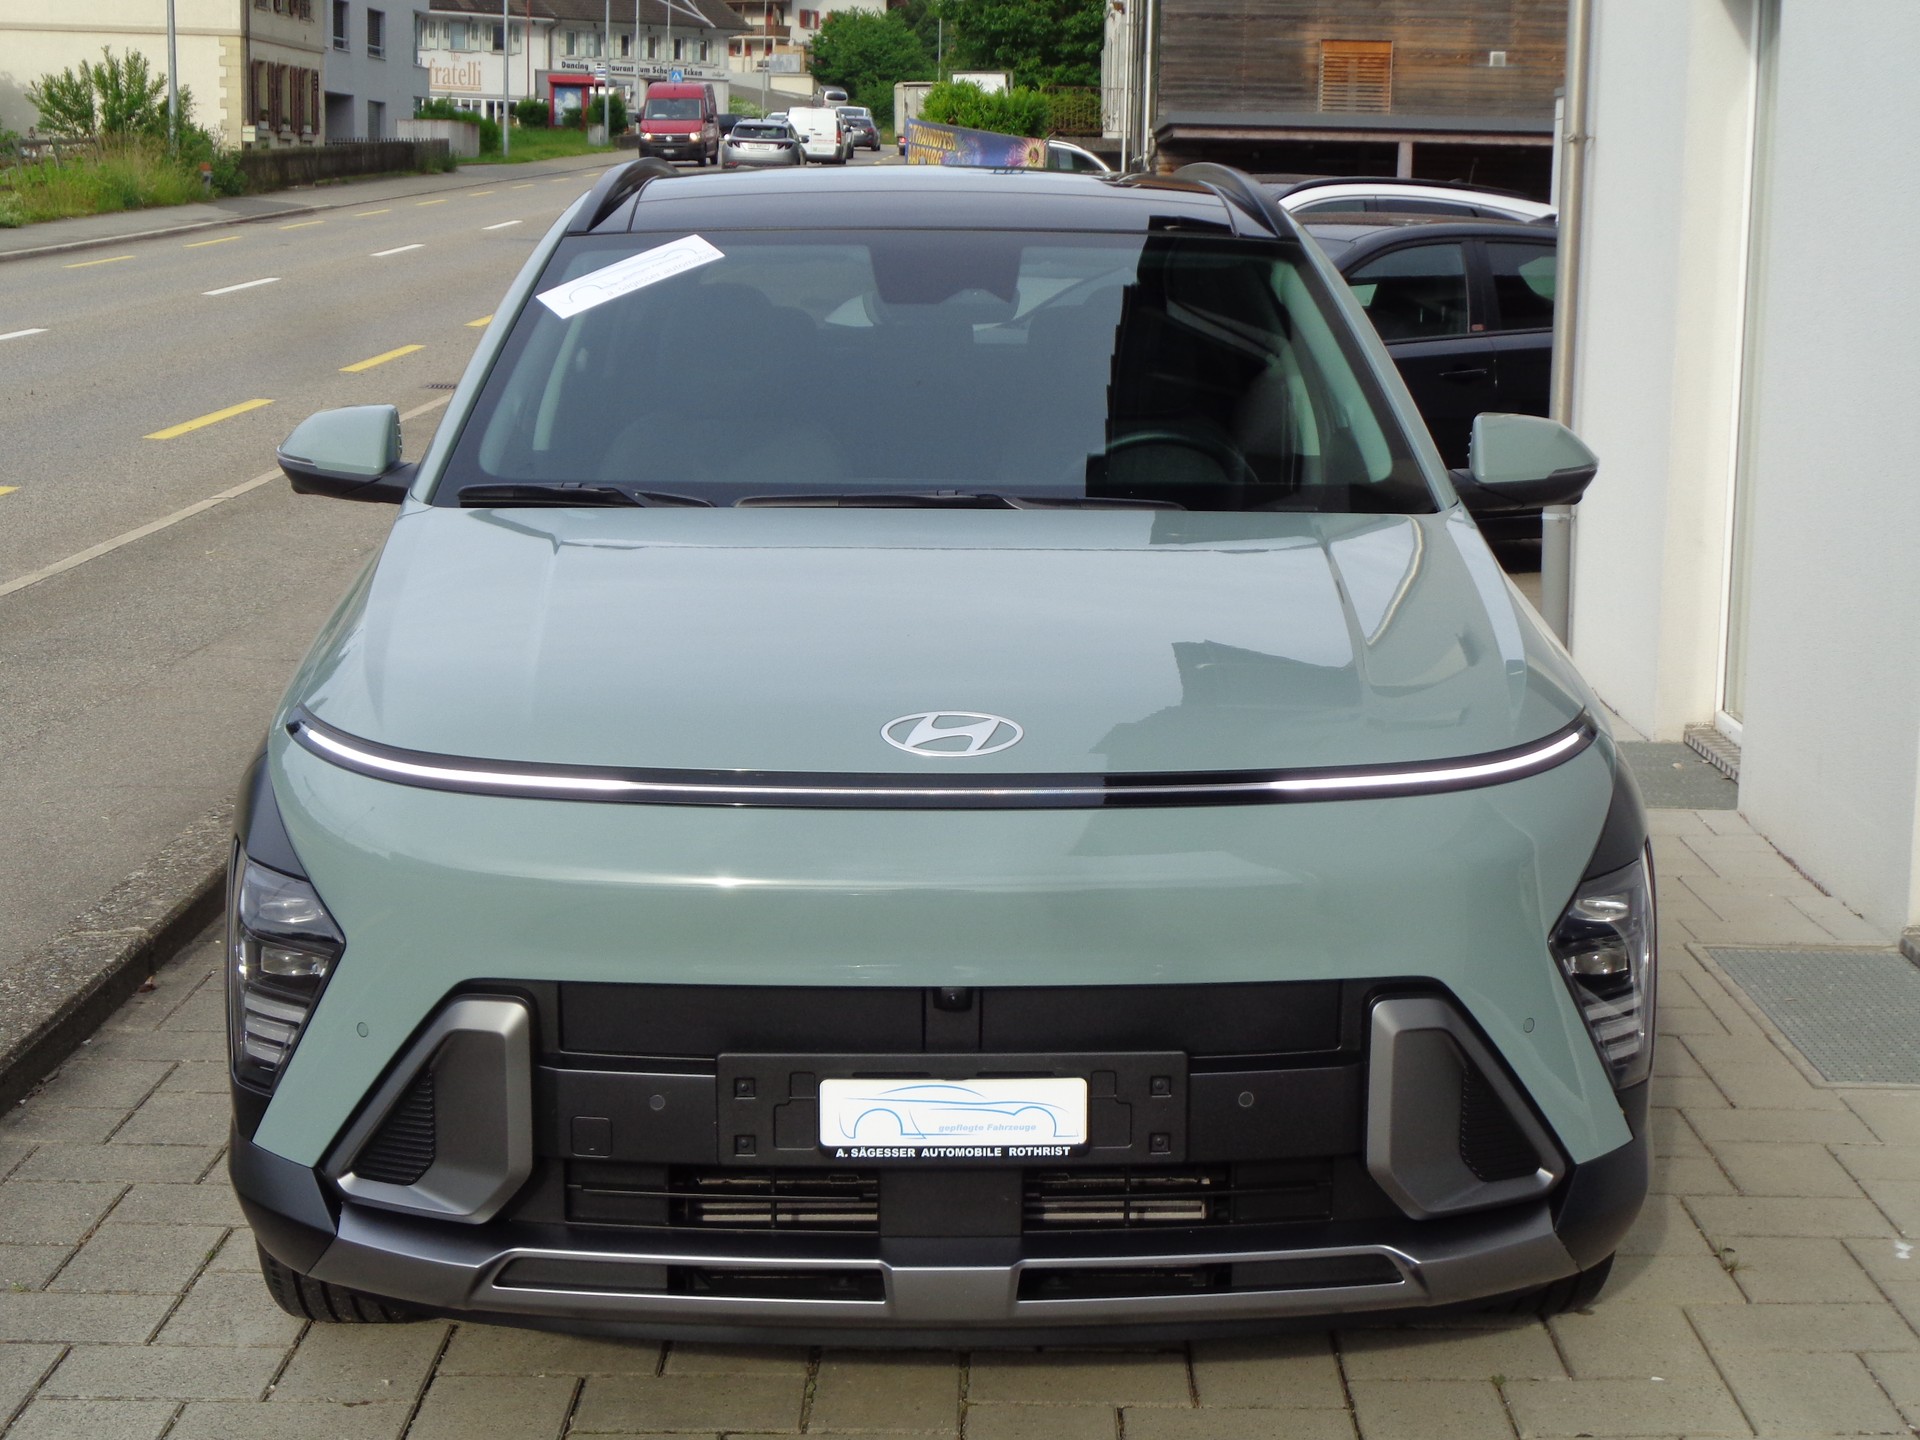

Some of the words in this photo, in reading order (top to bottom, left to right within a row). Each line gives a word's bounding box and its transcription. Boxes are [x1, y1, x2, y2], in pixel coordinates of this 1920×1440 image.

[429, 58, 482, 87] fratelli
[562, 61, 589, 71] Dancing
[684, 68, 702, 76] Ecken
[939, 1124, 984, 1132] gepflegte
[987, 1123, 1036, 1132] Fahrzeuge
[836, 1148, 848, 1157] A.
[851, 1146, 916, 1158] SÄGESSER
[921, 1147, 1002, 1157] AUTOMOBILE
[1009, 1146, 1071, 1157] ROTHRIST
